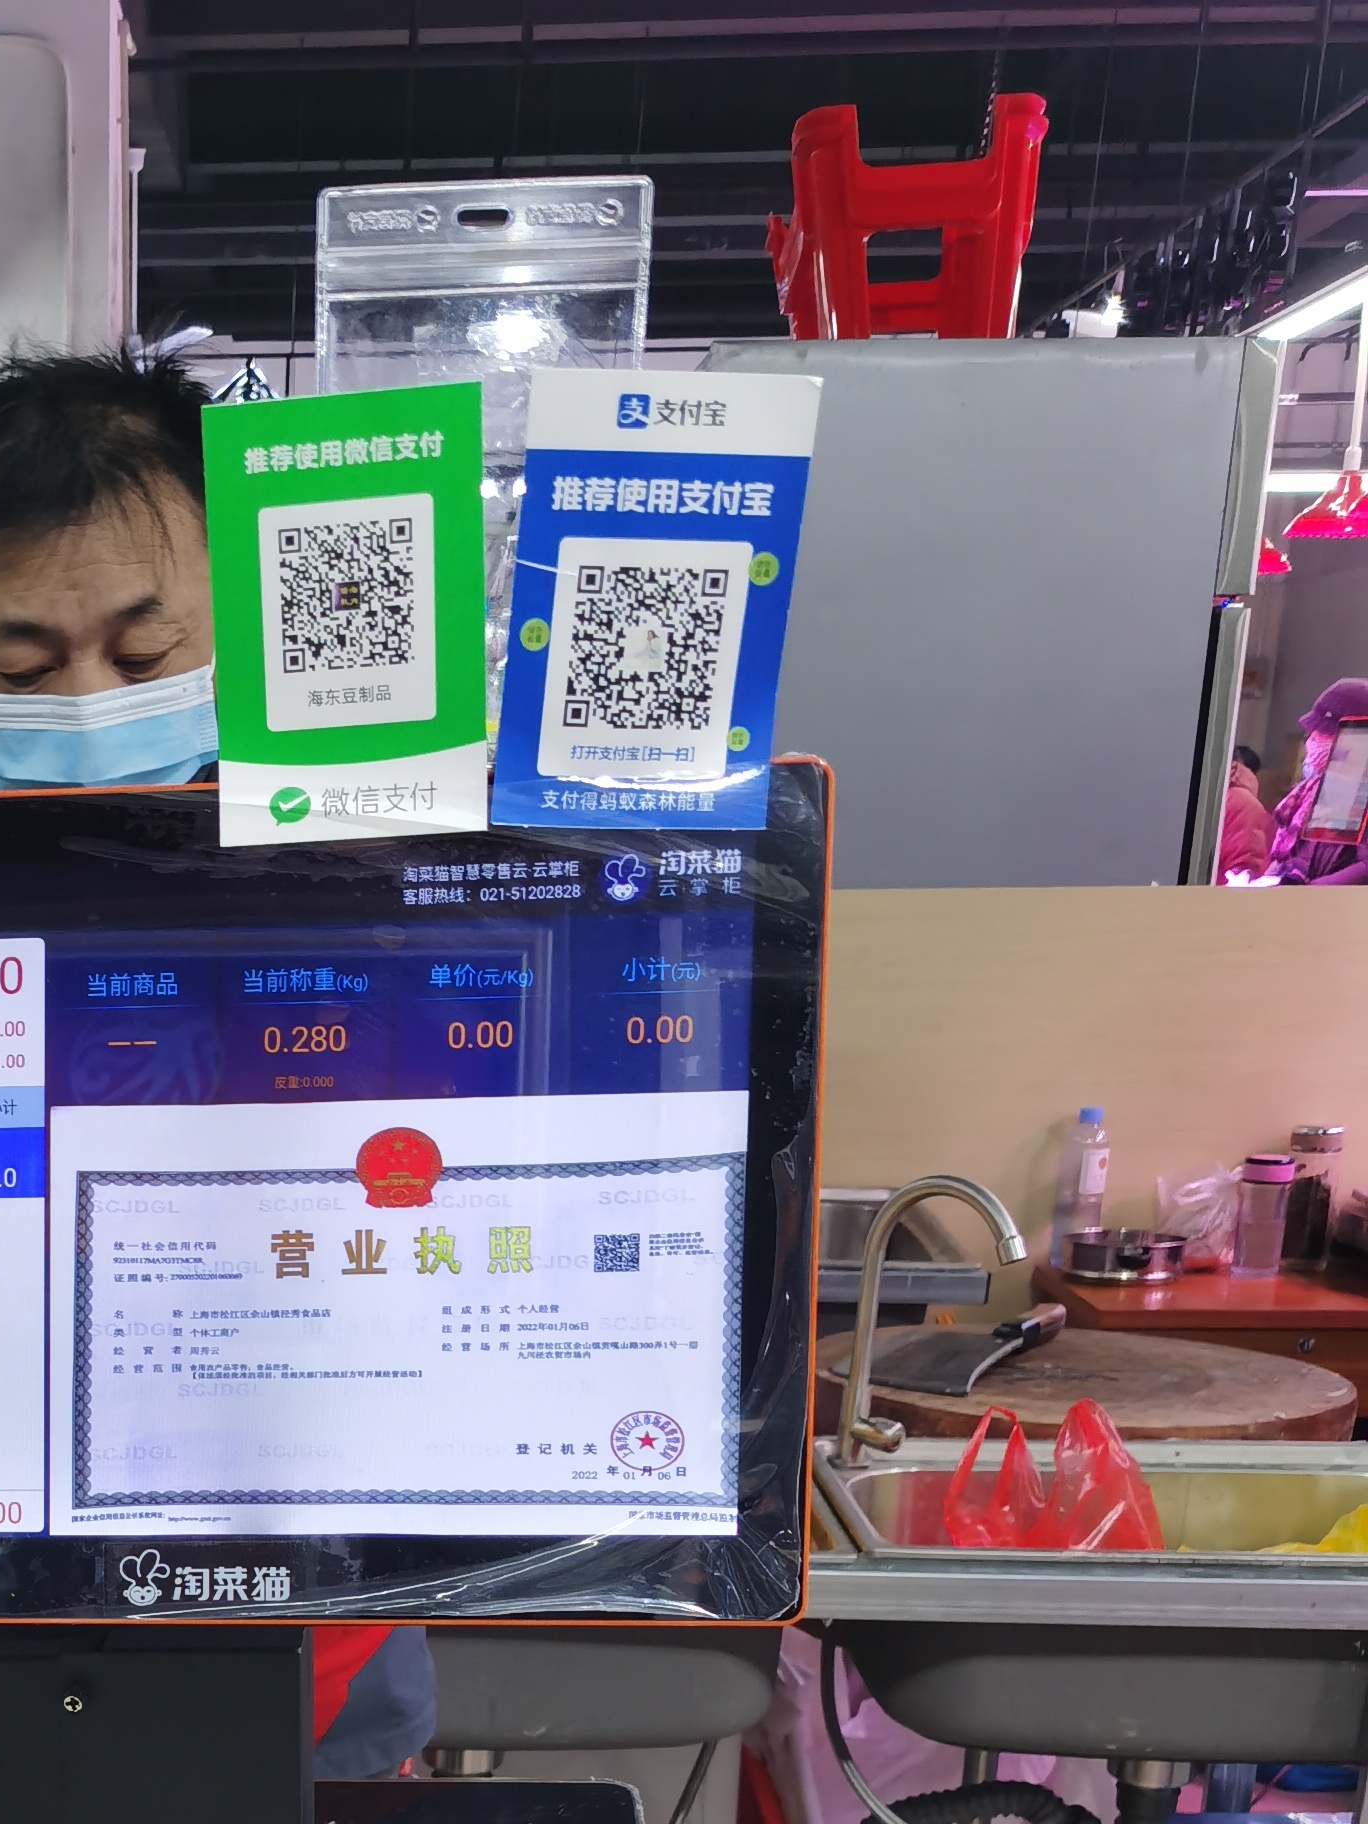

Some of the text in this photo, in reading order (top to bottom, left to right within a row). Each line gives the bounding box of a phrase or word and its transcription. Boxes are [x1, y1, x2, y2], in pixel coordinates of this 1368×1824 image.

[653, 401, 728, 428] 支付宝
[243, 431, 445, 475] 推荐使用微信支付
[551, 476, 775, 517] 推荐使用支付宝
[307, 684, 392, 709] 海东豆制品
[320, 781, 438, 817] 微信支付
[540, 790, 716, 814] 支付得蚂蚁森林能量
[658, 849, 743, 876] 淘菜猫
[658, 876, 742, 897] 云掌柜
[86, 972, 180, 998] 当前商品
[622, 958, 703, 985] 小计(元)
[263, 1015, 694, 1055] 0.280 0.00 0.00
[270, 1225, 535, 1280] 营业执照
[515, 1443, 598, 1456] 登记机关
[172, 1564, 292, 1604] 淘菜猫
